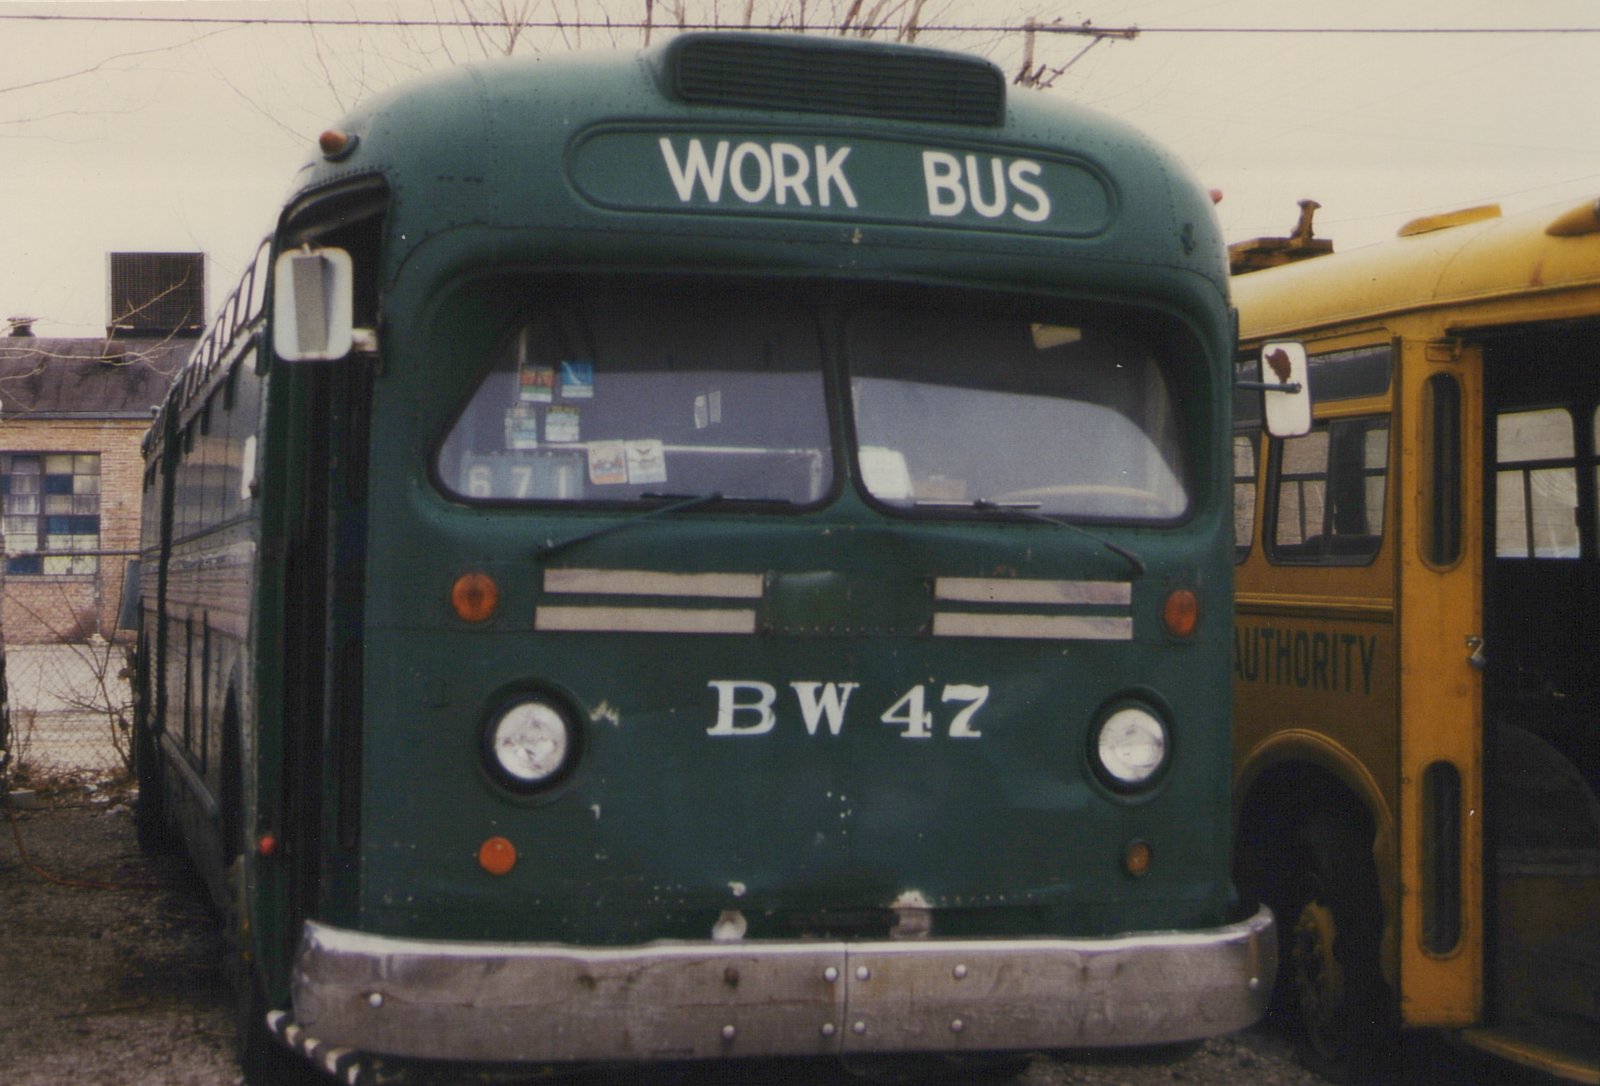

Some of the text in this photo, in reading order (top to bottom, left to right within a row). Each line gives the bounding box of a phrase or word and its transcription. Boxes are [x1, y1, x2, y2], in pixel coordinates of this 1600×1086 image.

[659, 138, 1050, 222] WORK BUS
[1234, 626, 1376, 695] AUTHORITY
[880, 684, 990, 737] 47
